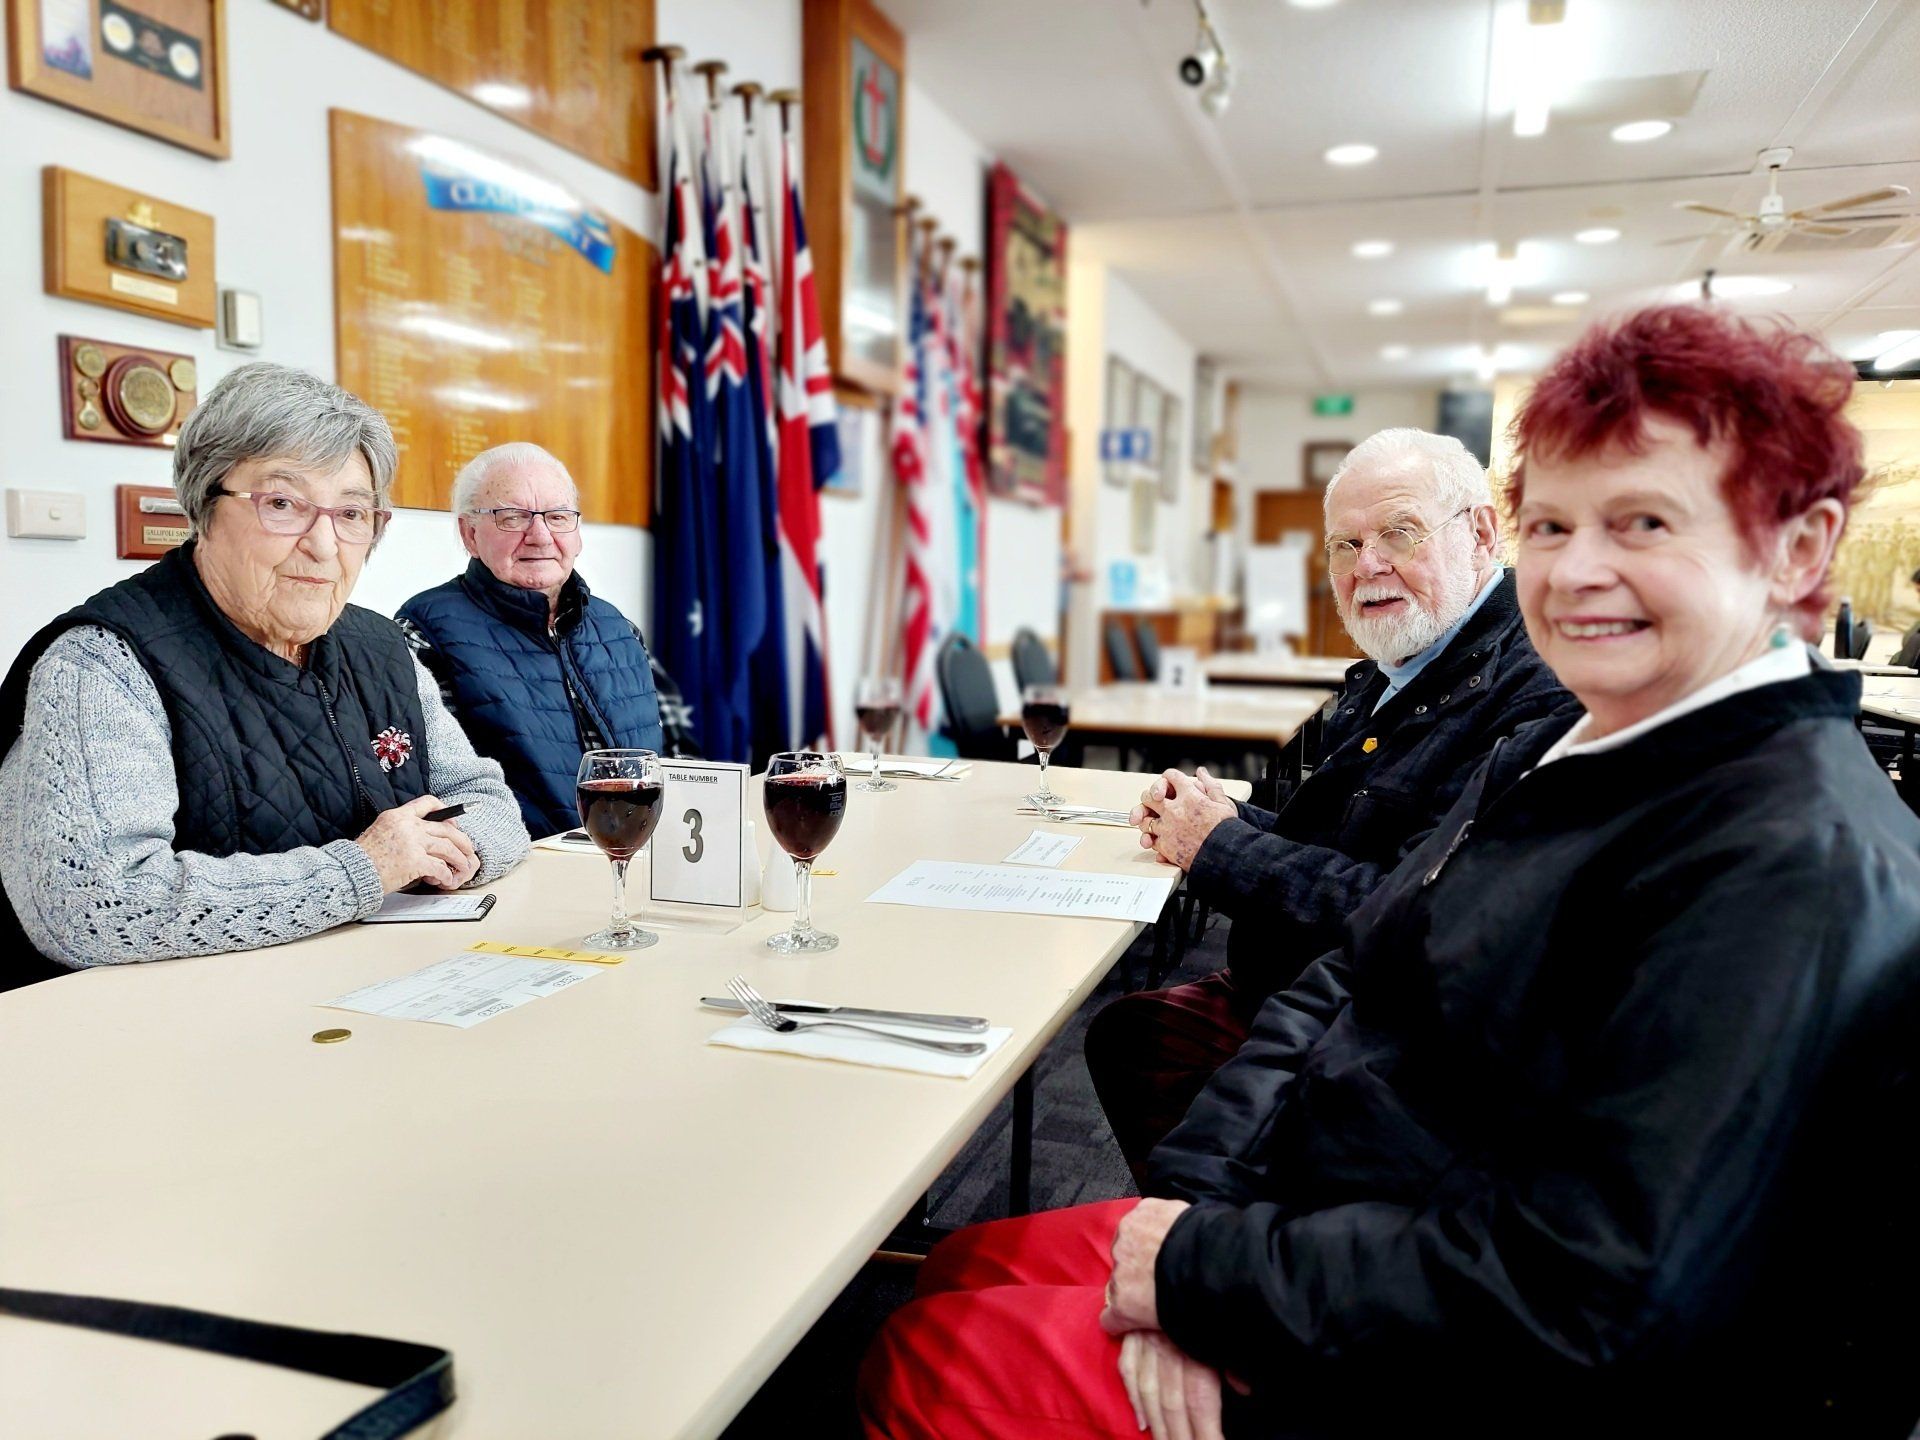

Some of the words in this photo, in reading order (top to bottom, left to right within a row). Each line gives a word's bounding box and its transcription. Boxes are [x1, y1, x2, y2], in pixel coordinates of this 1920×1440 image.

[145, 528, 174, 538] GALLIPOLI
[668, 773, 688, 781] TABLE
[688, 774, 718, 783] NUMBER
[682, 808, 704, 864] 3
